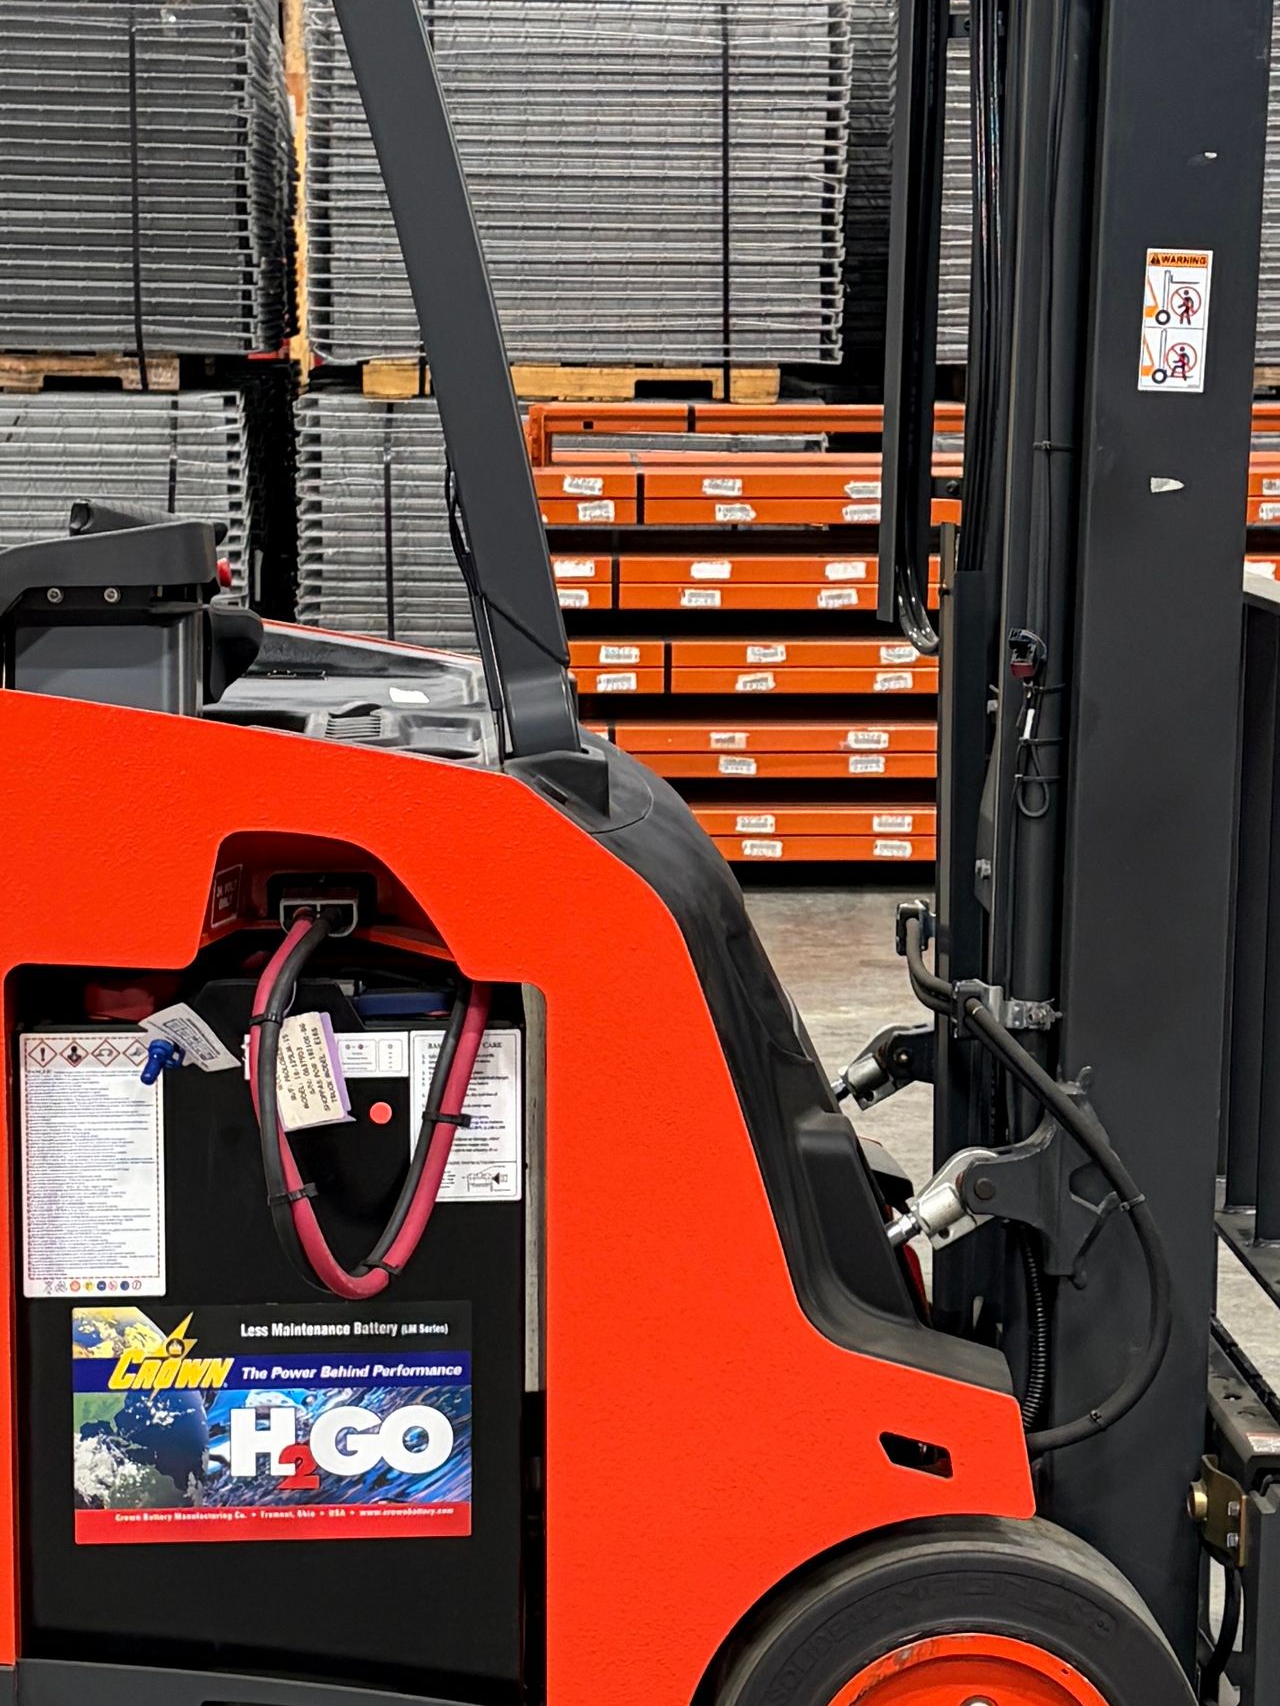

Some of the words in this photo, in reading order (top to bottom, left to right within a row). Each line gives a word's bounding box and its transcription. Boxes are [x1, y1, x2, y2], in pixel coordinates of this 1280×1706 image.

[1161, 255, 1207, 264] WARNING
[240, 1323, 268, 1337] Less
[271, 1322, 350, 1337] Maintenance
[354, 1322, 398, 1337] Battery
[419, 1323, 448, 1335] Series)
[108, 1349, 234, 1390] CROWN
[241, 1366, 267, 1380] The
[271, 1366, 316, 1379] Power
[321, 1364, 369, 1378] Behind
[372, 1363, 462, 1378] Performance
[115, 1513, 141, 1522] Crown
[143, 1512, 172, 1522] Battery
[174, 1511, 233, 1521] Manufacturing
[297, 1510, 315, 1518] Ohio
[328, 1509, 346, 1517] USA
